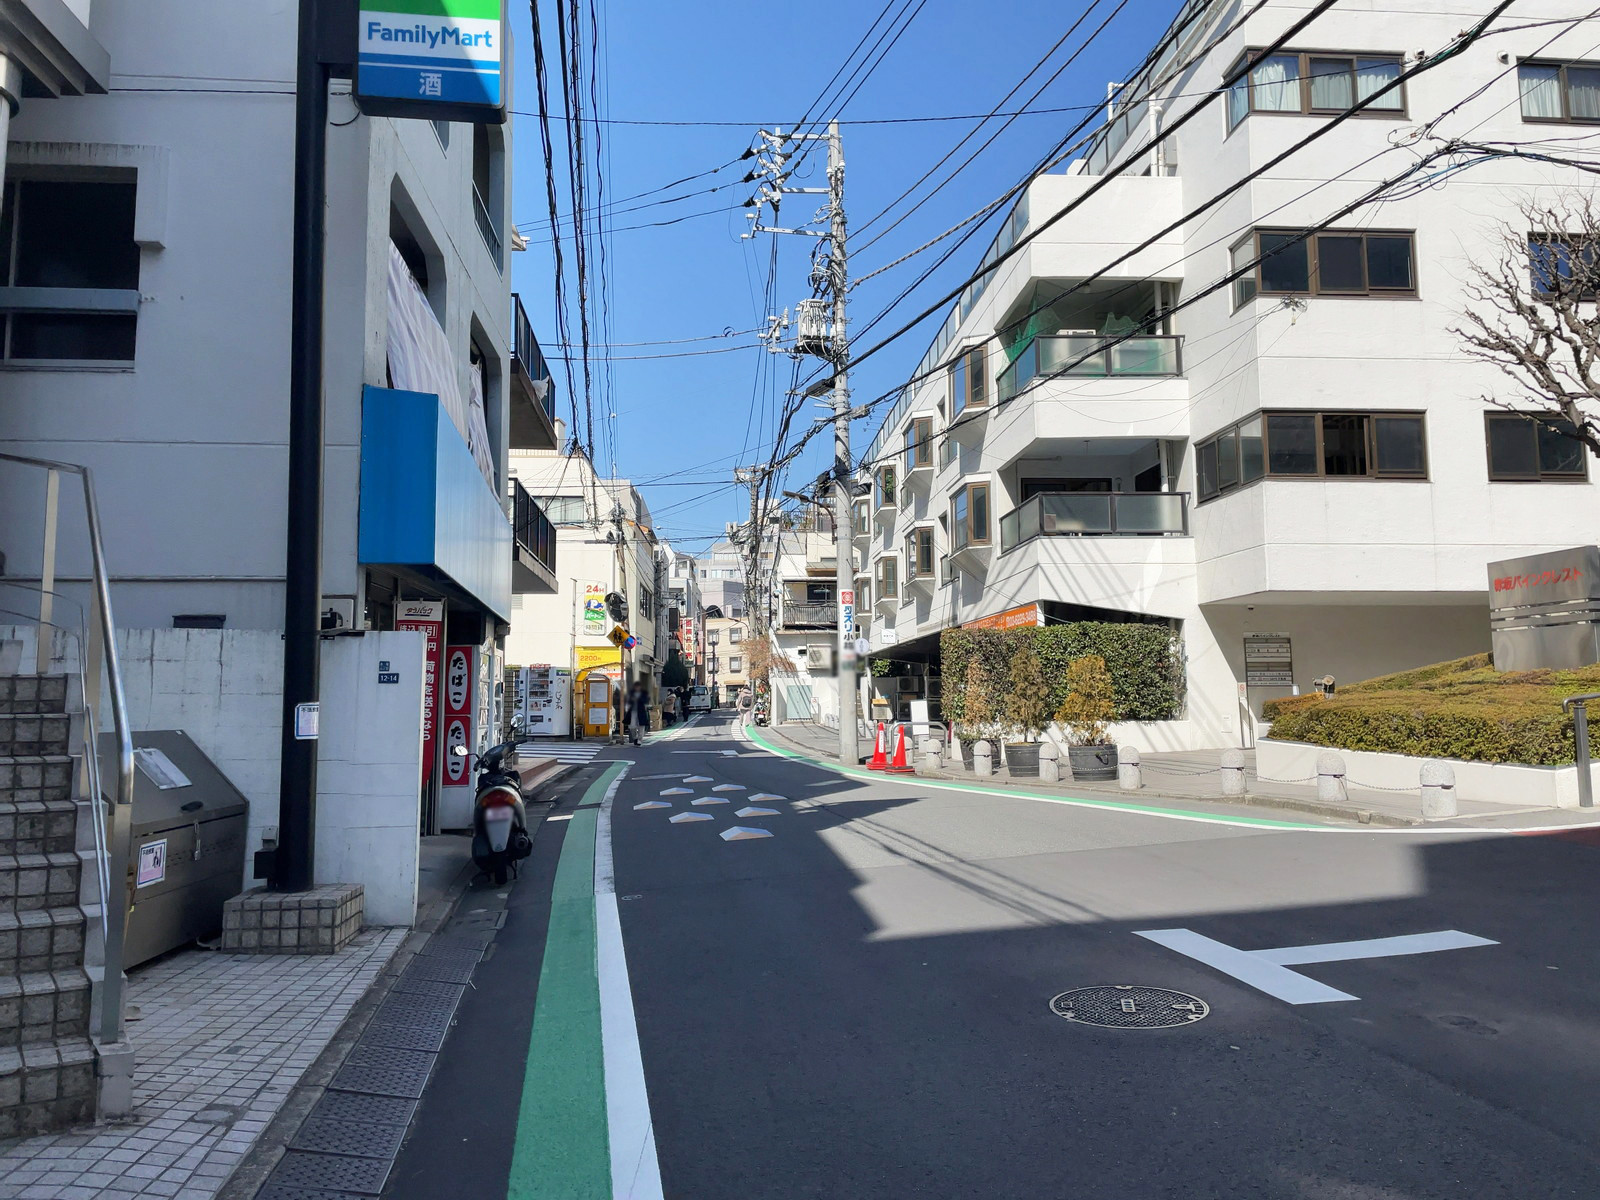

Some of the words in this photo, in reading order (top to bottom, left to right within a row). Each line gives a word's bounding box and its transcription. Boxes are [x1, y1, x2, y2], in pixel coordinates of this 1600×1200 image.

[367, 22, 493, 49] FamilyMart
[418, 71, 442, 97] 酒
[427, 641, 437, 652] 円
[380, 675, 397, 683] 12-14
[451, 655, 467, 705] たばこ
